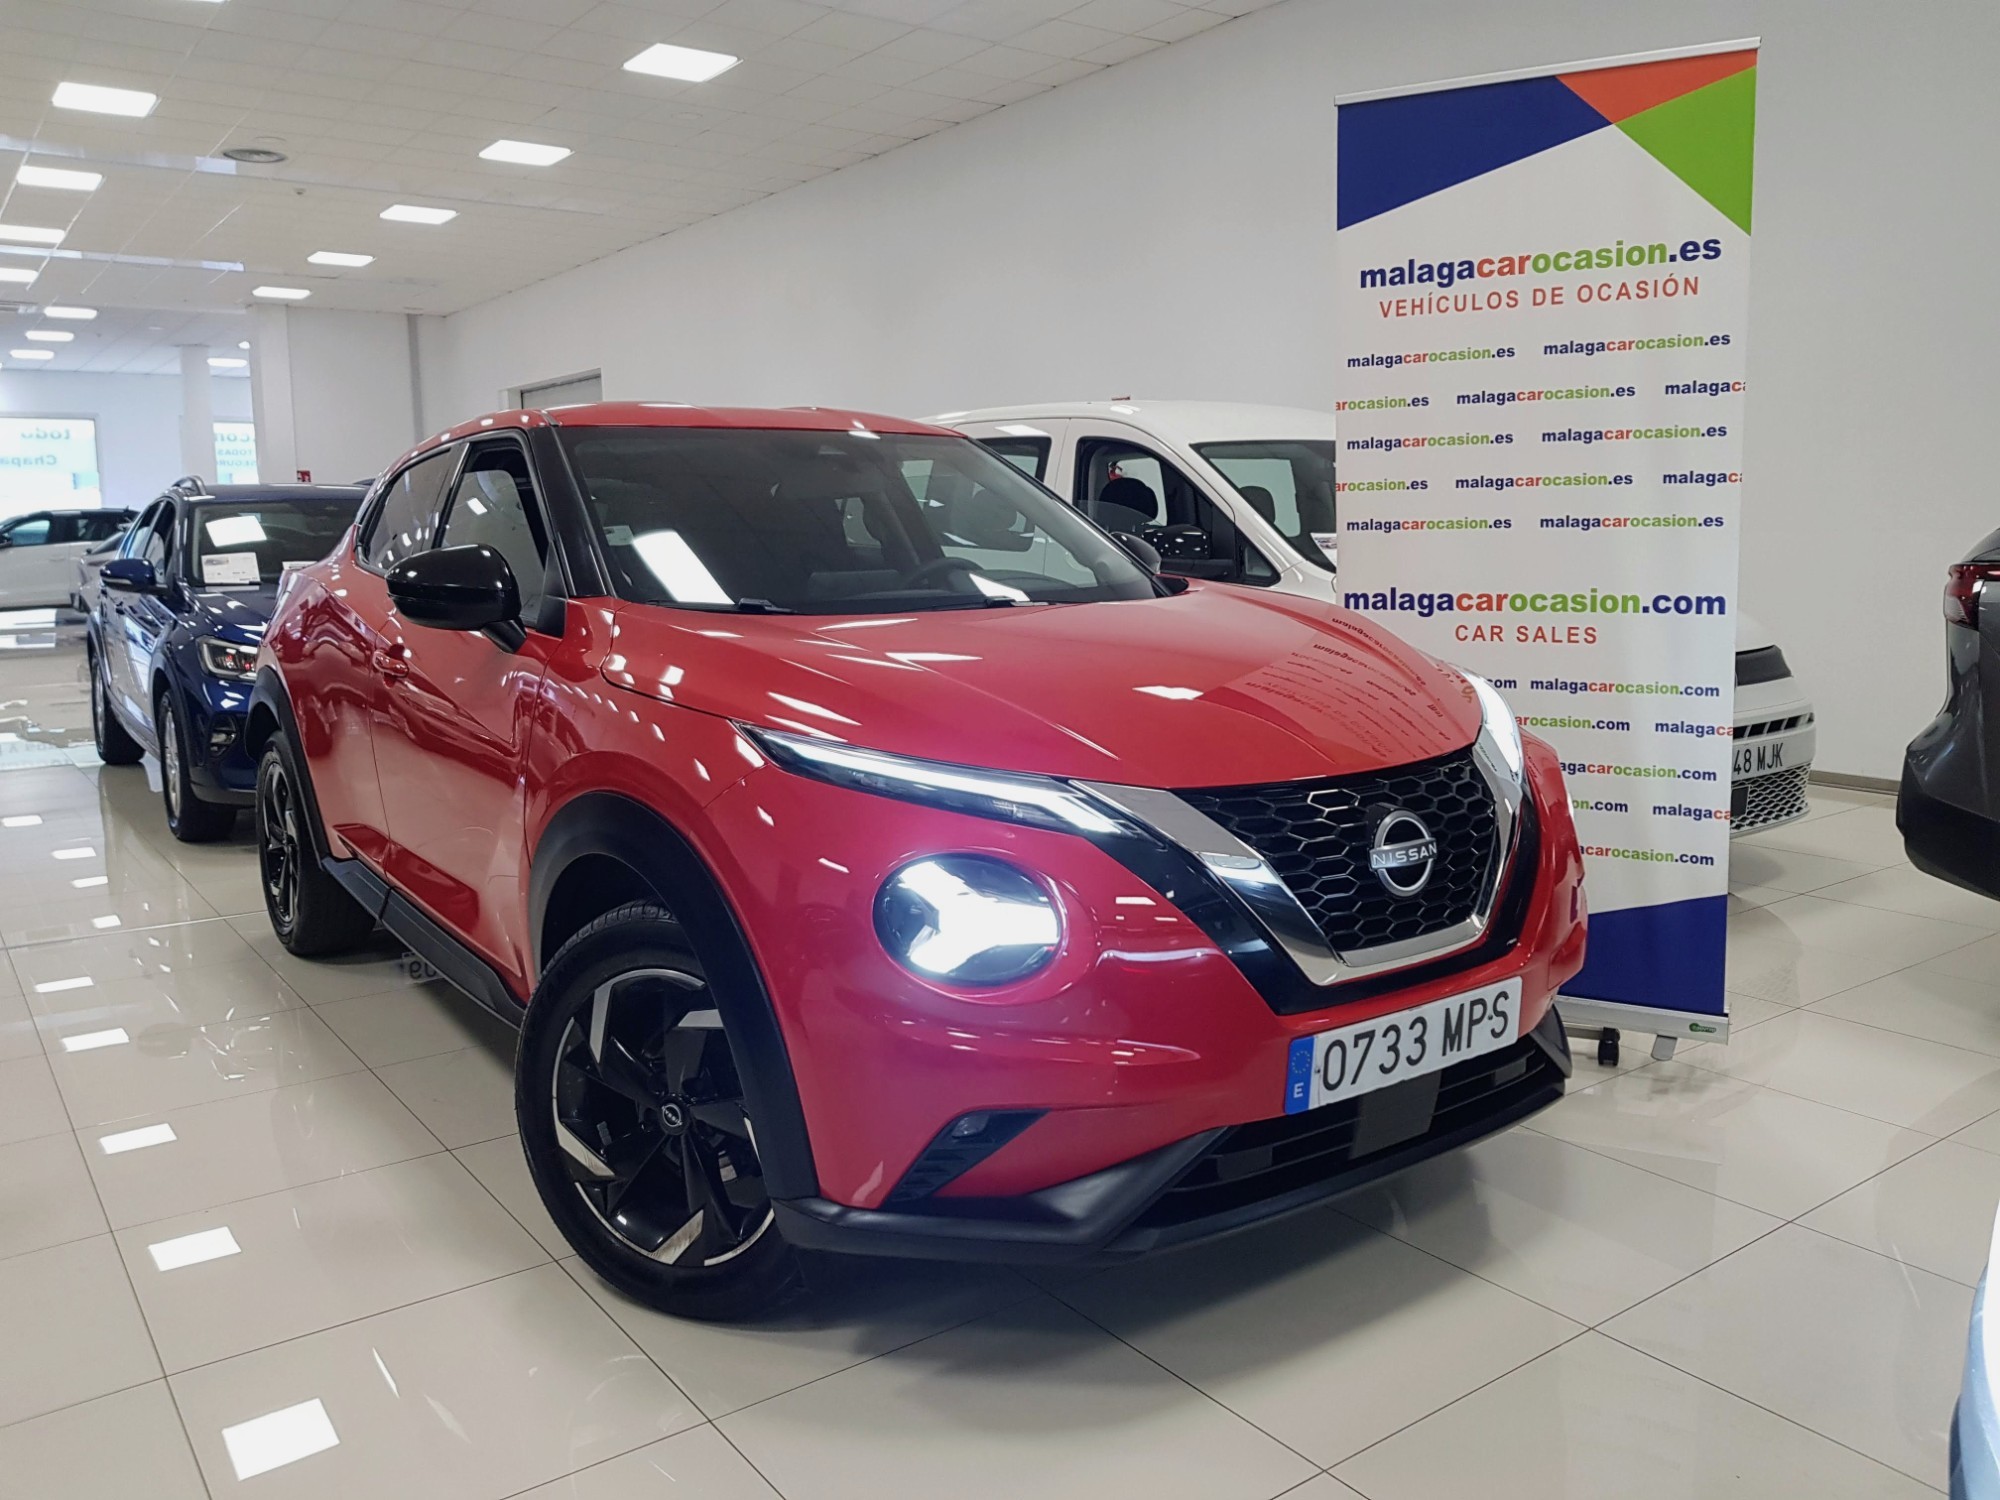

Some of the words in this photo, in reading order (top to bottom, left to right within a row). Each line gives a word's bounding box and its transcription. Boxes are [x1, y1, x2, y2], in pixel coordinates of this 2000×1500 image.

[1360, 238, 1722, 289] malagacarocasion.es
[1379, 290, 1519, 318] VEHÍCULOS
[1532, 287, 1564, 306] DE
[1577, 273, 1699, 304] OCASIÓN
[1543, 334, 1731, 357] malagacarocasion.es
[1347, 347, 1515, 369] malagacarocasion.es
[1456, 385, 1636, 406] malagacarocasion.es
[1346, 432, 1514, 452] malagacarocasion.es
[1542, 425, 1727, 445] malagacarocasion.es
[1455, 472, 1633, 491] malagacarocasion.es
[1346, 517, 1512, 534] malagacarocasion.es
[1540, 514, 1724, 532] malagacarocasion.es
[1344, 587, 1726, 618] malagacarocasion.com
[1455, 624, 1504, 642] CAR
[1516, 625, 1597, 644] SALES
[1530, 678, 1720, 697] malagacarocasion.com
[1733, 749, 1752, 775] 48
[1757, 742, 1783, 771] MJK
[1373, 842, 1437, 865] NISSAN
[1322, 1016, 1428, 1092] 0733
[1441, 990, 1510, 1057] MPS
[1293, 1082, 1304, 1098] E
